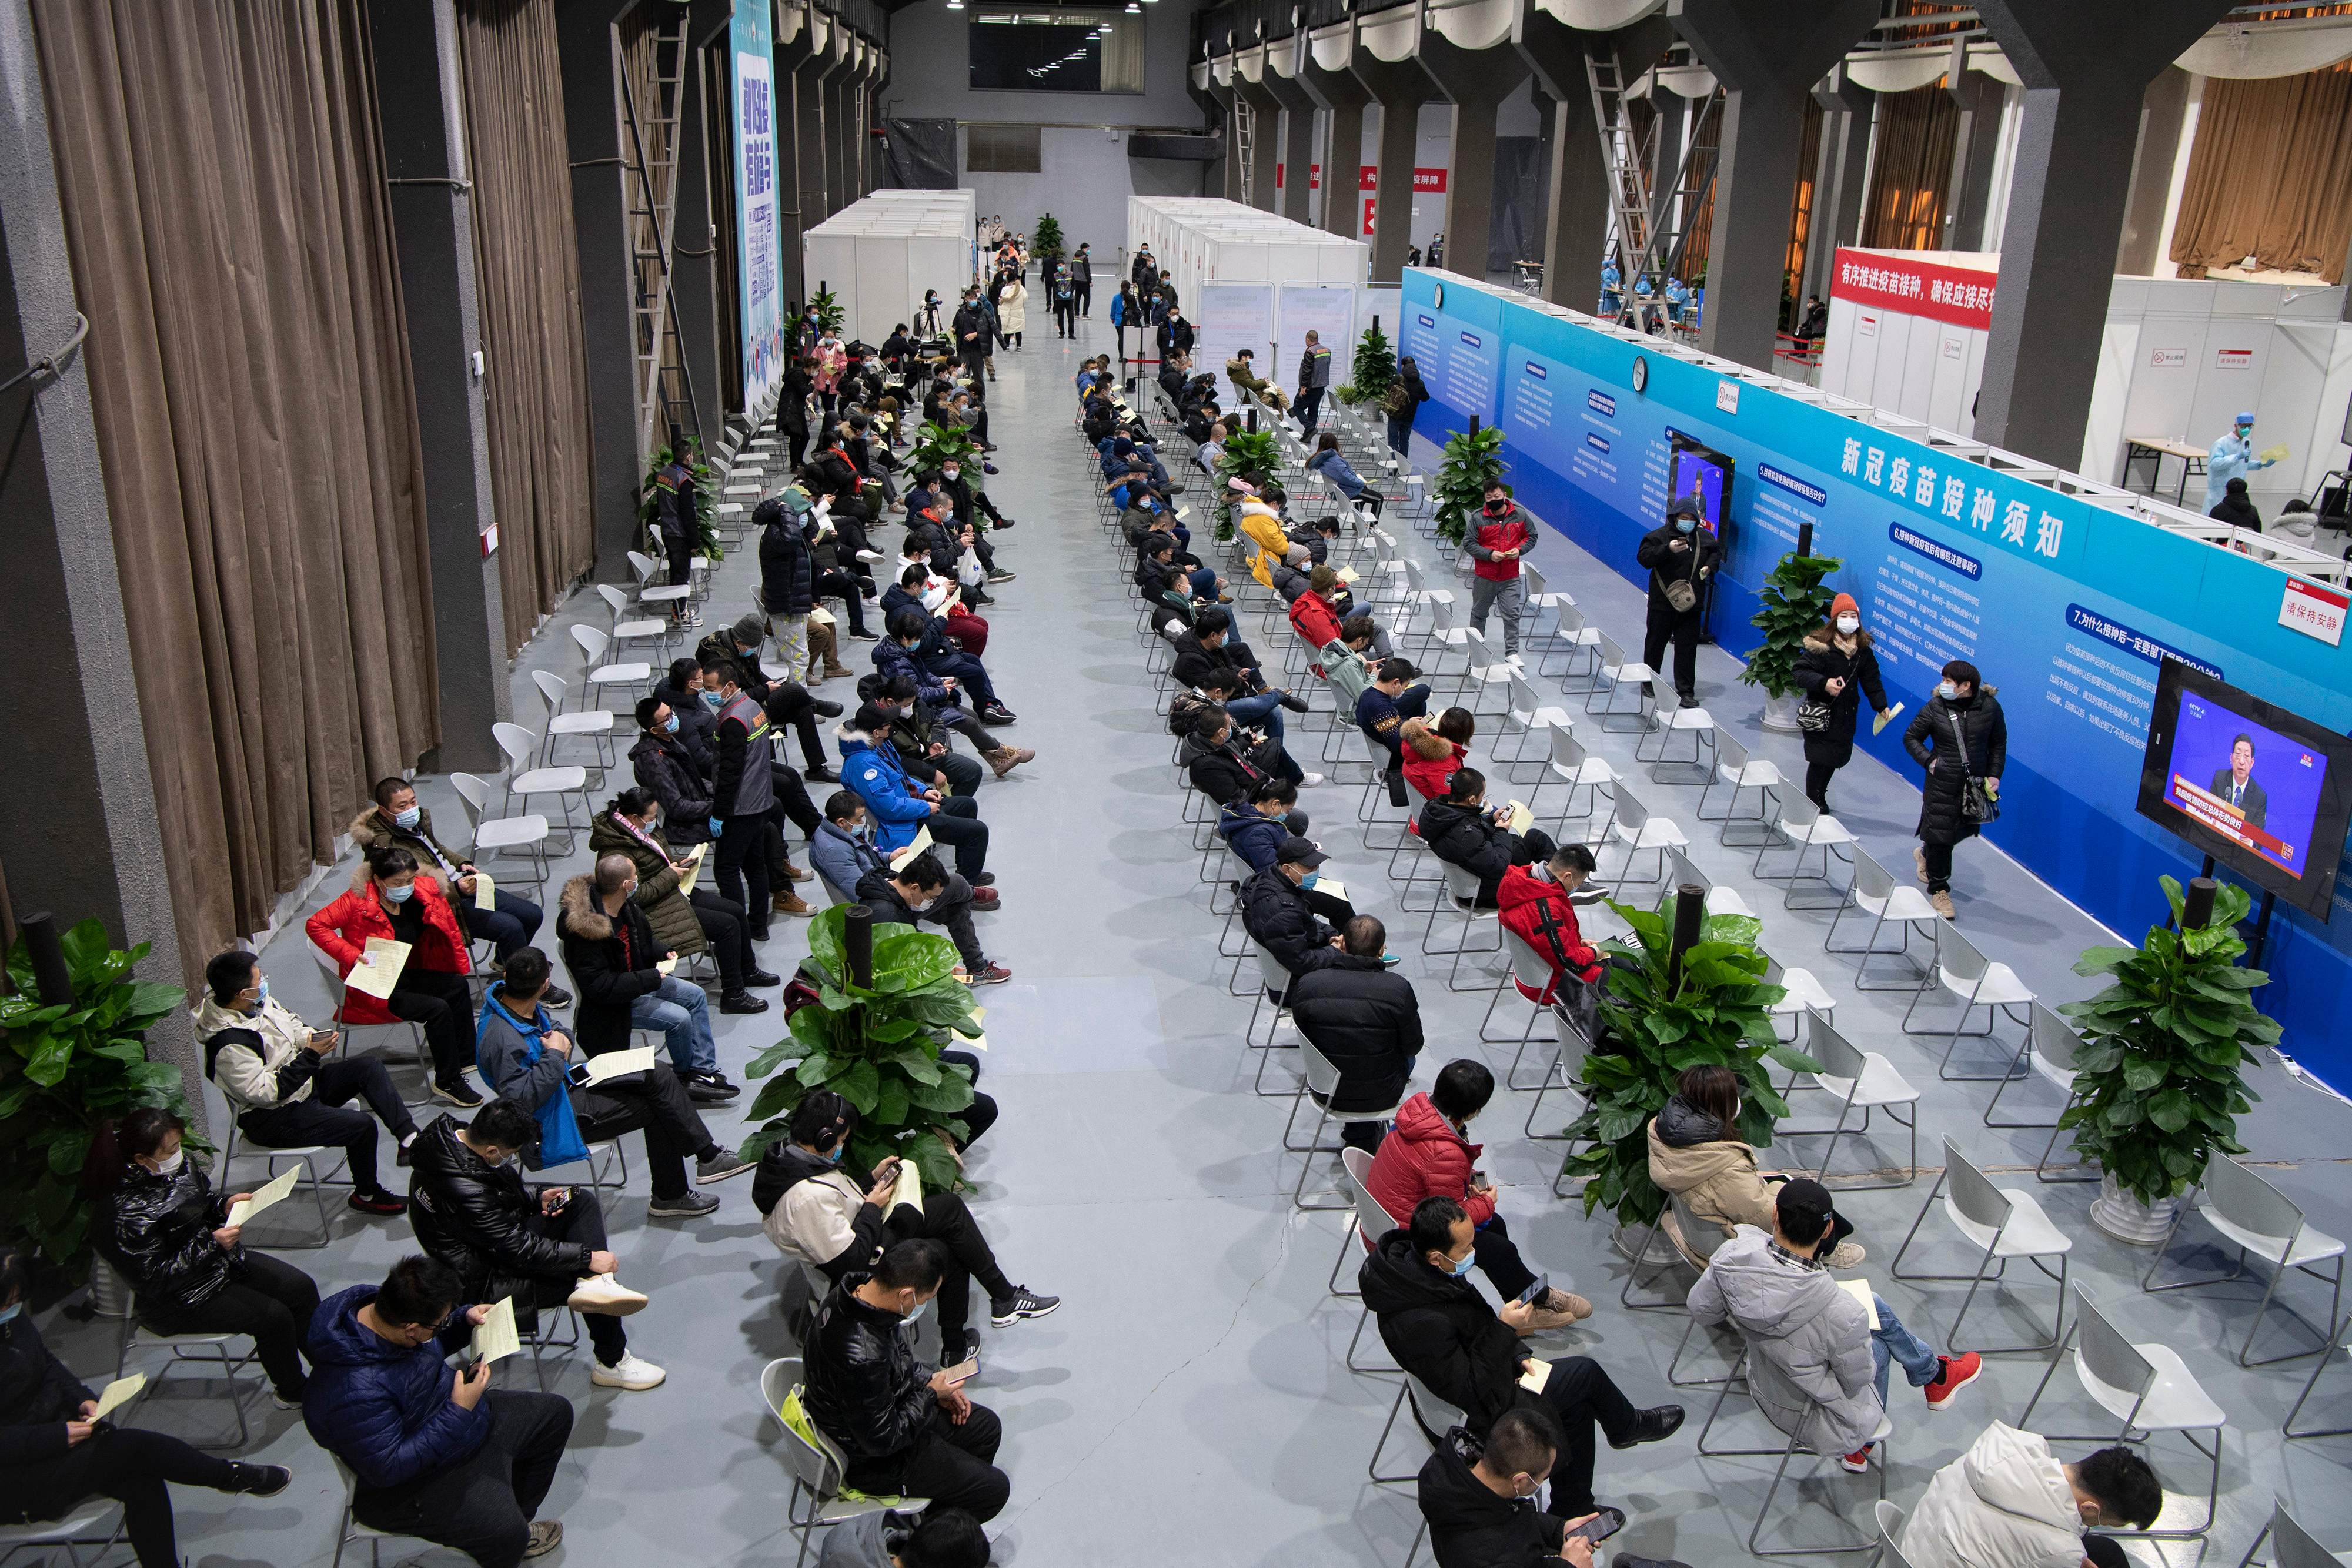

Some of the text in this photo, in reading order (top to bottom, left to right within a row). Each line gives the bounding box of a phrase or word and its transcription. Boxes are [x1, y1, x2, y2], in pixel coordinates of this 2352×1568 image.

[1841, 437, 2064, 559] 新冠疫苗接种须知
[2286, 601, 2337, 631] 请保持安静
[2175, 787, 2243, 830] 我国疫情防控总体形势良好
